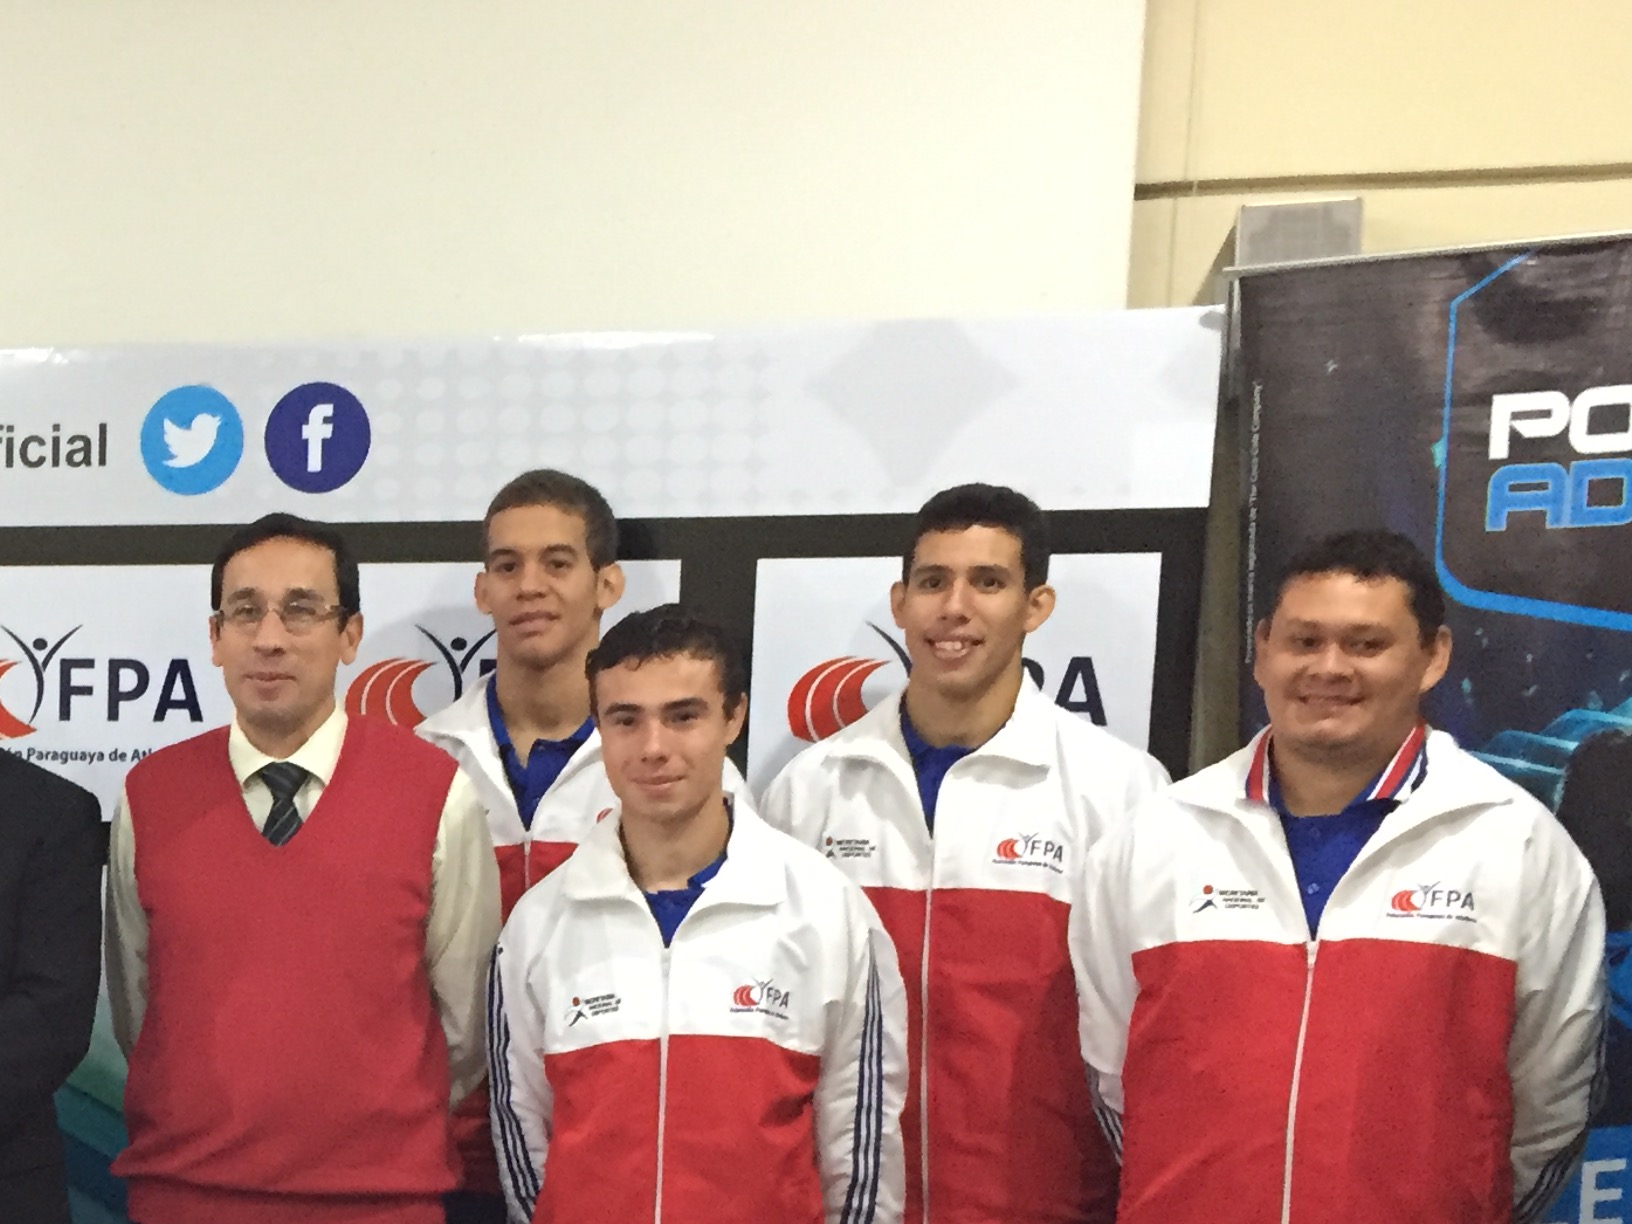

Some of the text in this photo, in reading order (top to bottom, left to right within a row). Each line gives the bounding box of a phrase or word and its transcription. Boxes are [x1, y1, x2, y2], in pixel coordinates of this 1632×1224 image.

[1488, 384, 1632, 460] PO
[1485, 458, 1632, 532] AD
[58, 658, 204, 722] FPA
[26, 749, 105, 765] Paraguaya
[108, 747, 127, 762] de
[1430, 889, 1475, 912] FPA
